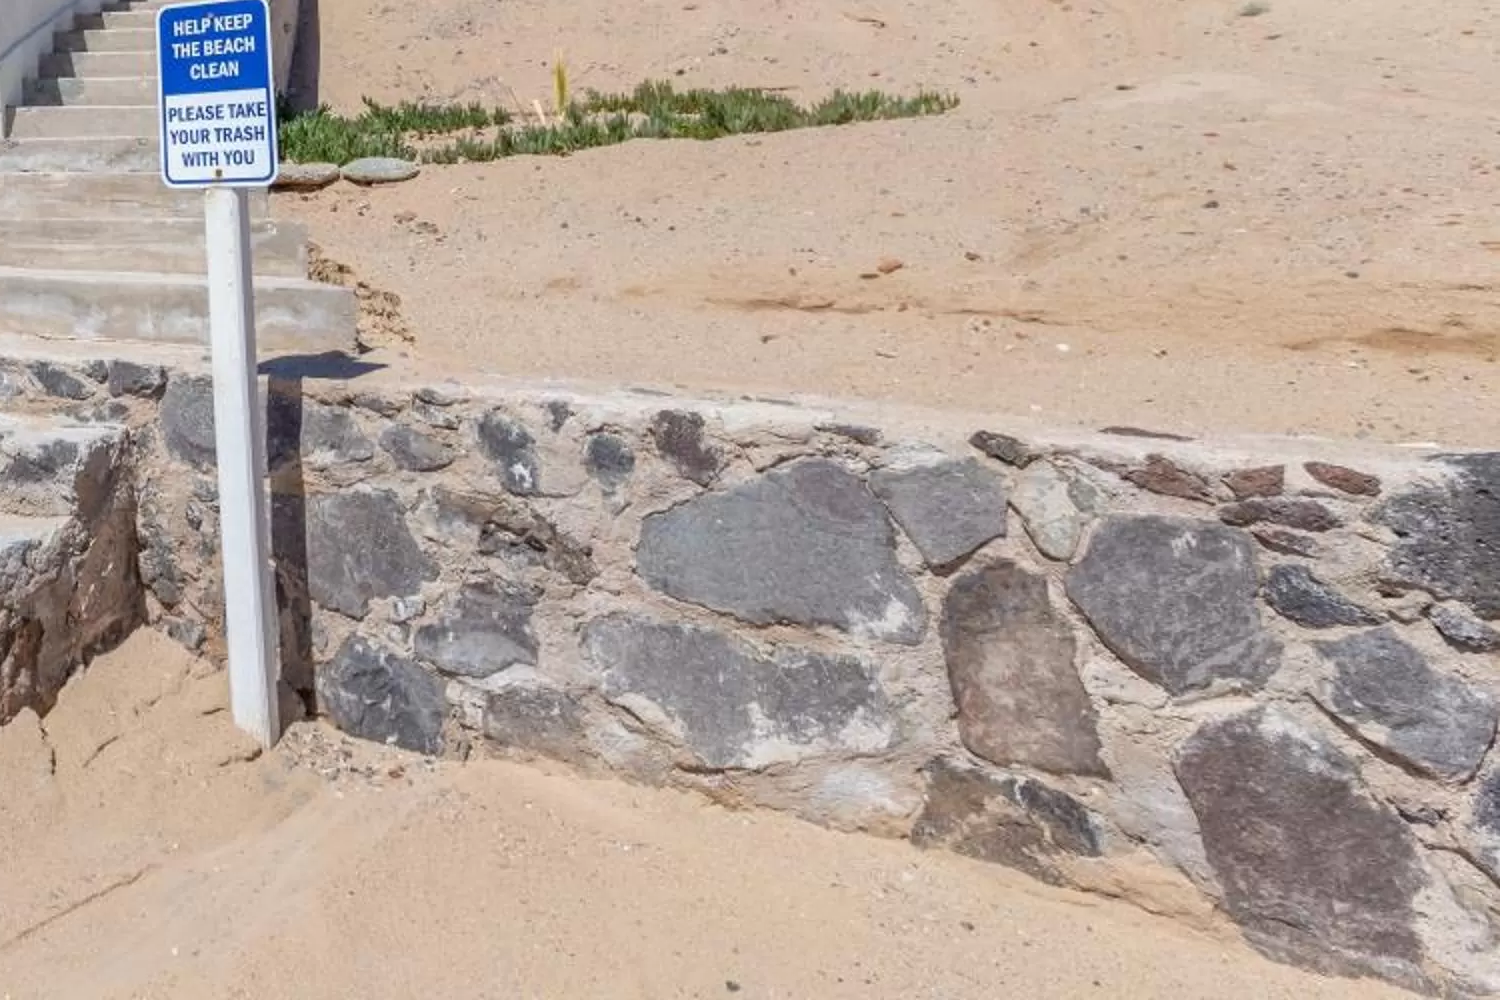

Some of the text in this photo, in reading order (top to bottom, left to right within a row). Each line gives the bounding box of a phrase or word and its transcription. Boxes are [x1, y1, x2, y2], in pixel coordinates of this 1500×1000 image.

[173, 13, 253, 37] HELP KEEP
[172, 36, 255, 59] THE BEACH
[190, 60, 239, 80] CLEAN
[168, 101, 266, 123] PLEASE TAKE
[170, 126, 264, 145] YOUR TRASH
[182, 150, 254, 167] WITH YOU
